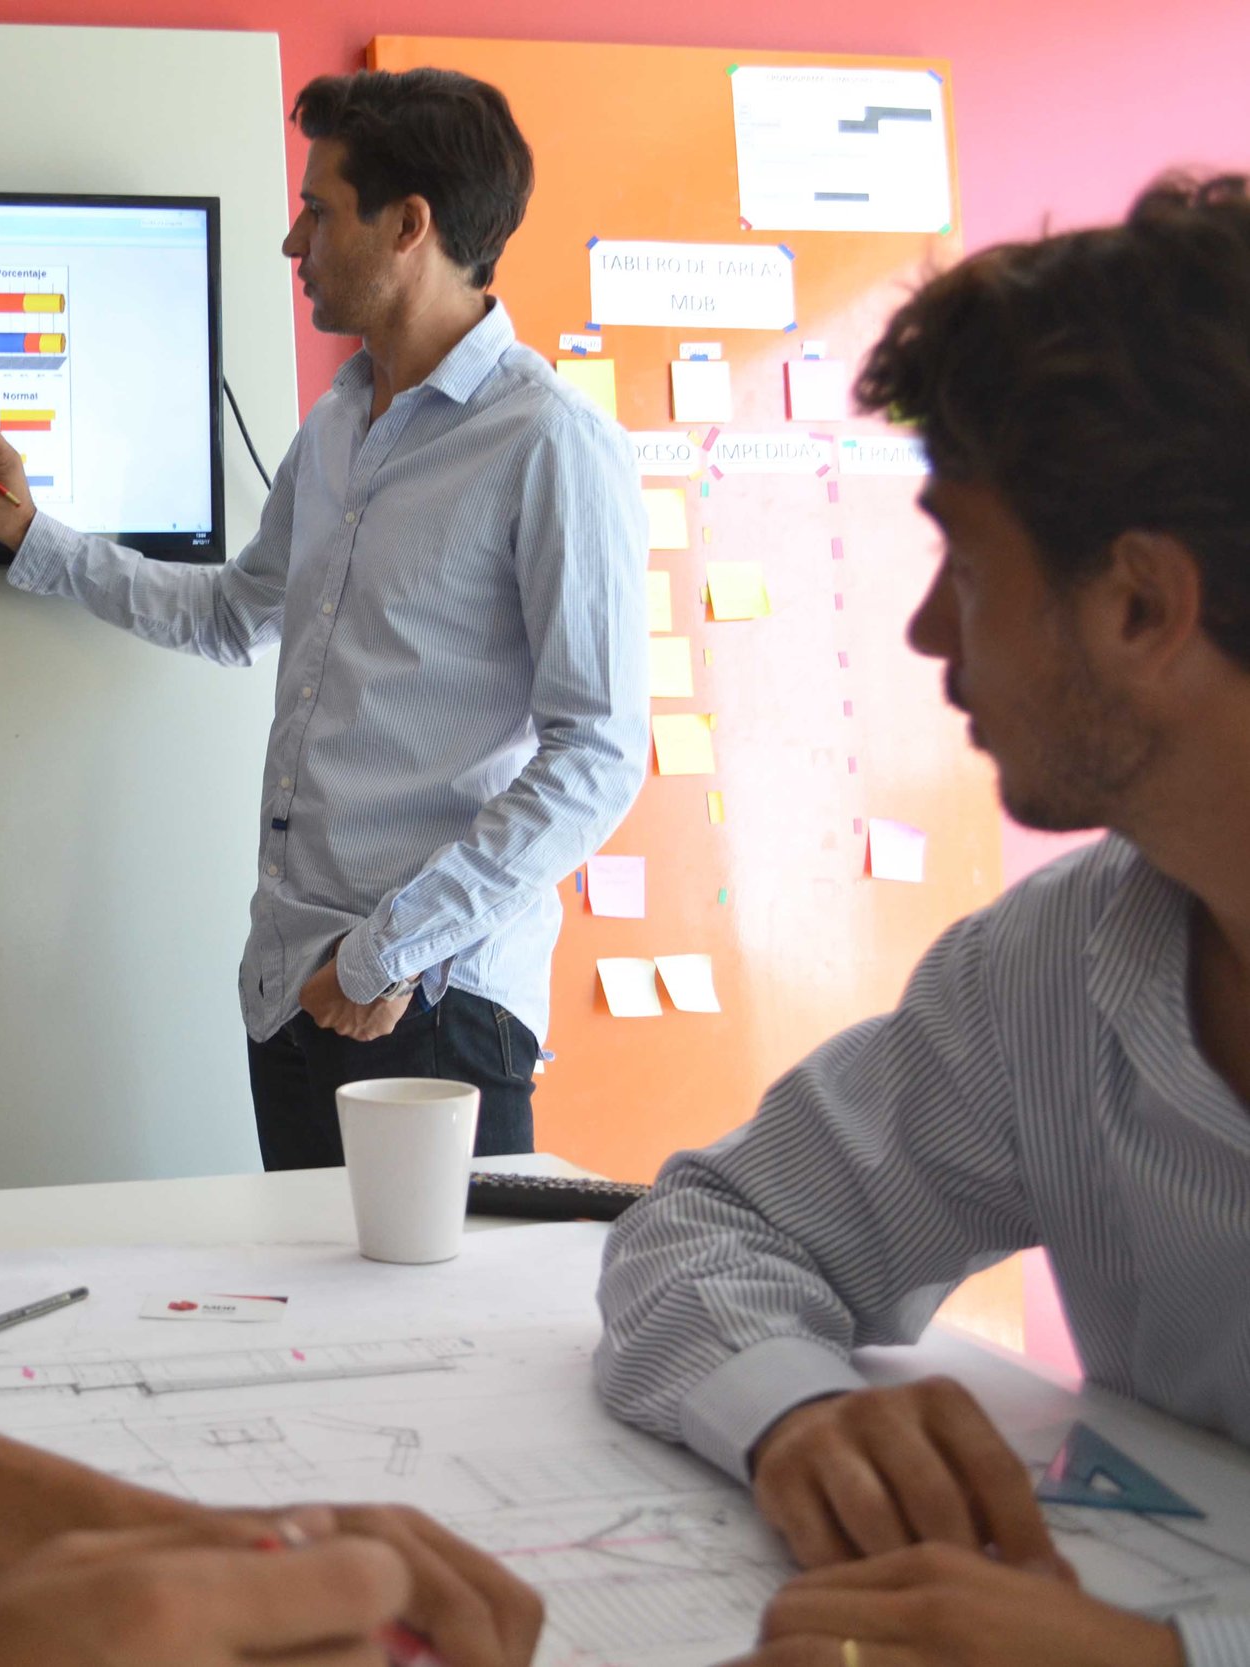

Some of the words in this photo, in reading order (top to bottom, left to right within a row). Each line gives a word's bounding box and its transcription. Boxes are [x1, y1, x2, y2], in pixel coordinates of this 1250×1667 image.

[600, 254, 681, 274] TABLERO
[686, 258, 707, 275] DE
[716, 260, 783, 278] TAREAS
[670, 293, 716, 313] MDB
[3, 391, 38, 400] Normal
[715, 442, 823, 462] IMPEDIDAS
[848, 445, 922, 463] TERMIN
